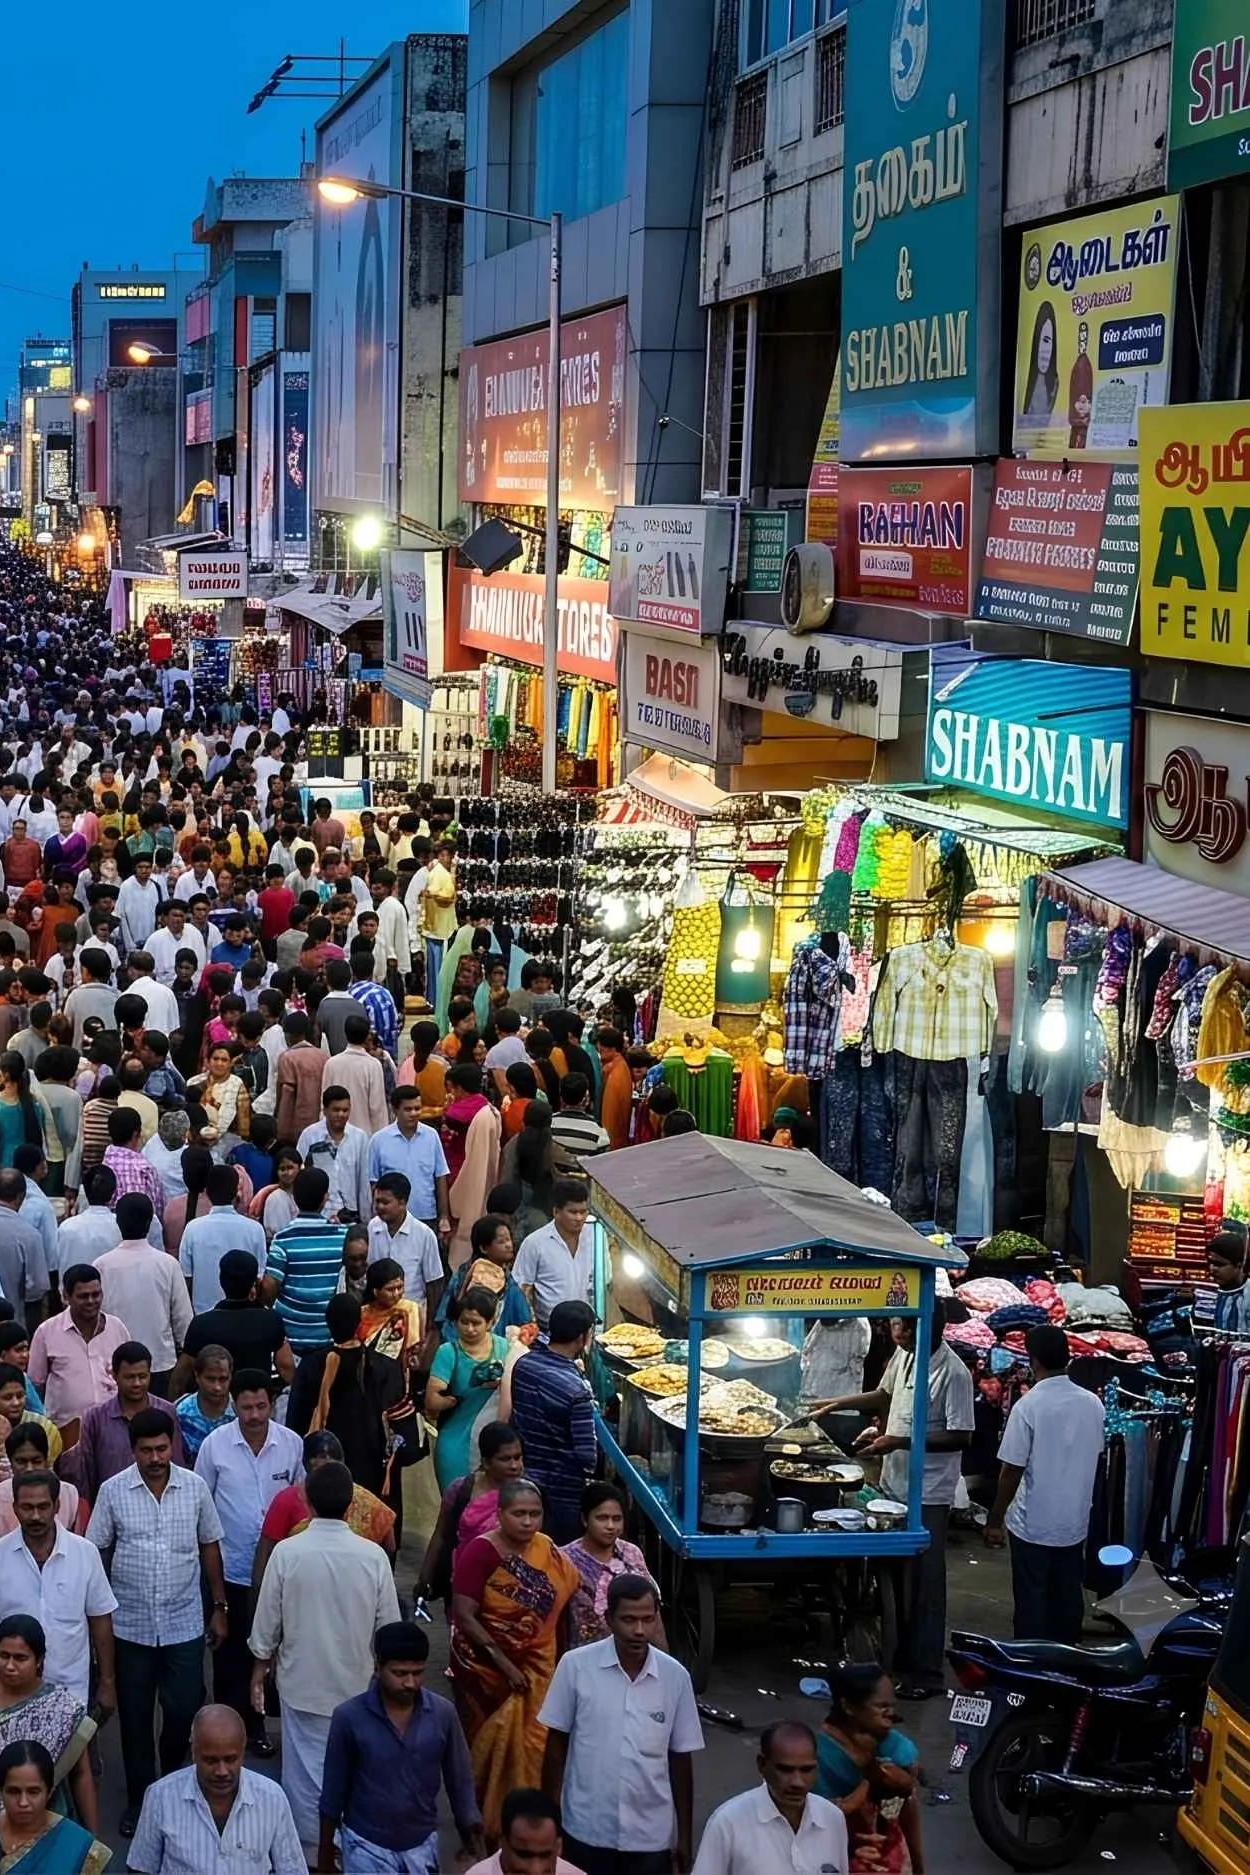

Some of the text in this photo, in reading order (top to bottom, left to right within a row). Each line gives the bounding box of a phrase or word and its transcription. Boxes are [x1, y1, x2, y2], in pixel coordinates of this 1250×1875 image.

[895, 246, 913, 301] &
[846, 310, 968, 392] SHABNAM
[1152, 506, 1250, 592] AY
[1157, 602, 1250, 646] FEM
[931, 709, 1125, 819] SHABNAM
